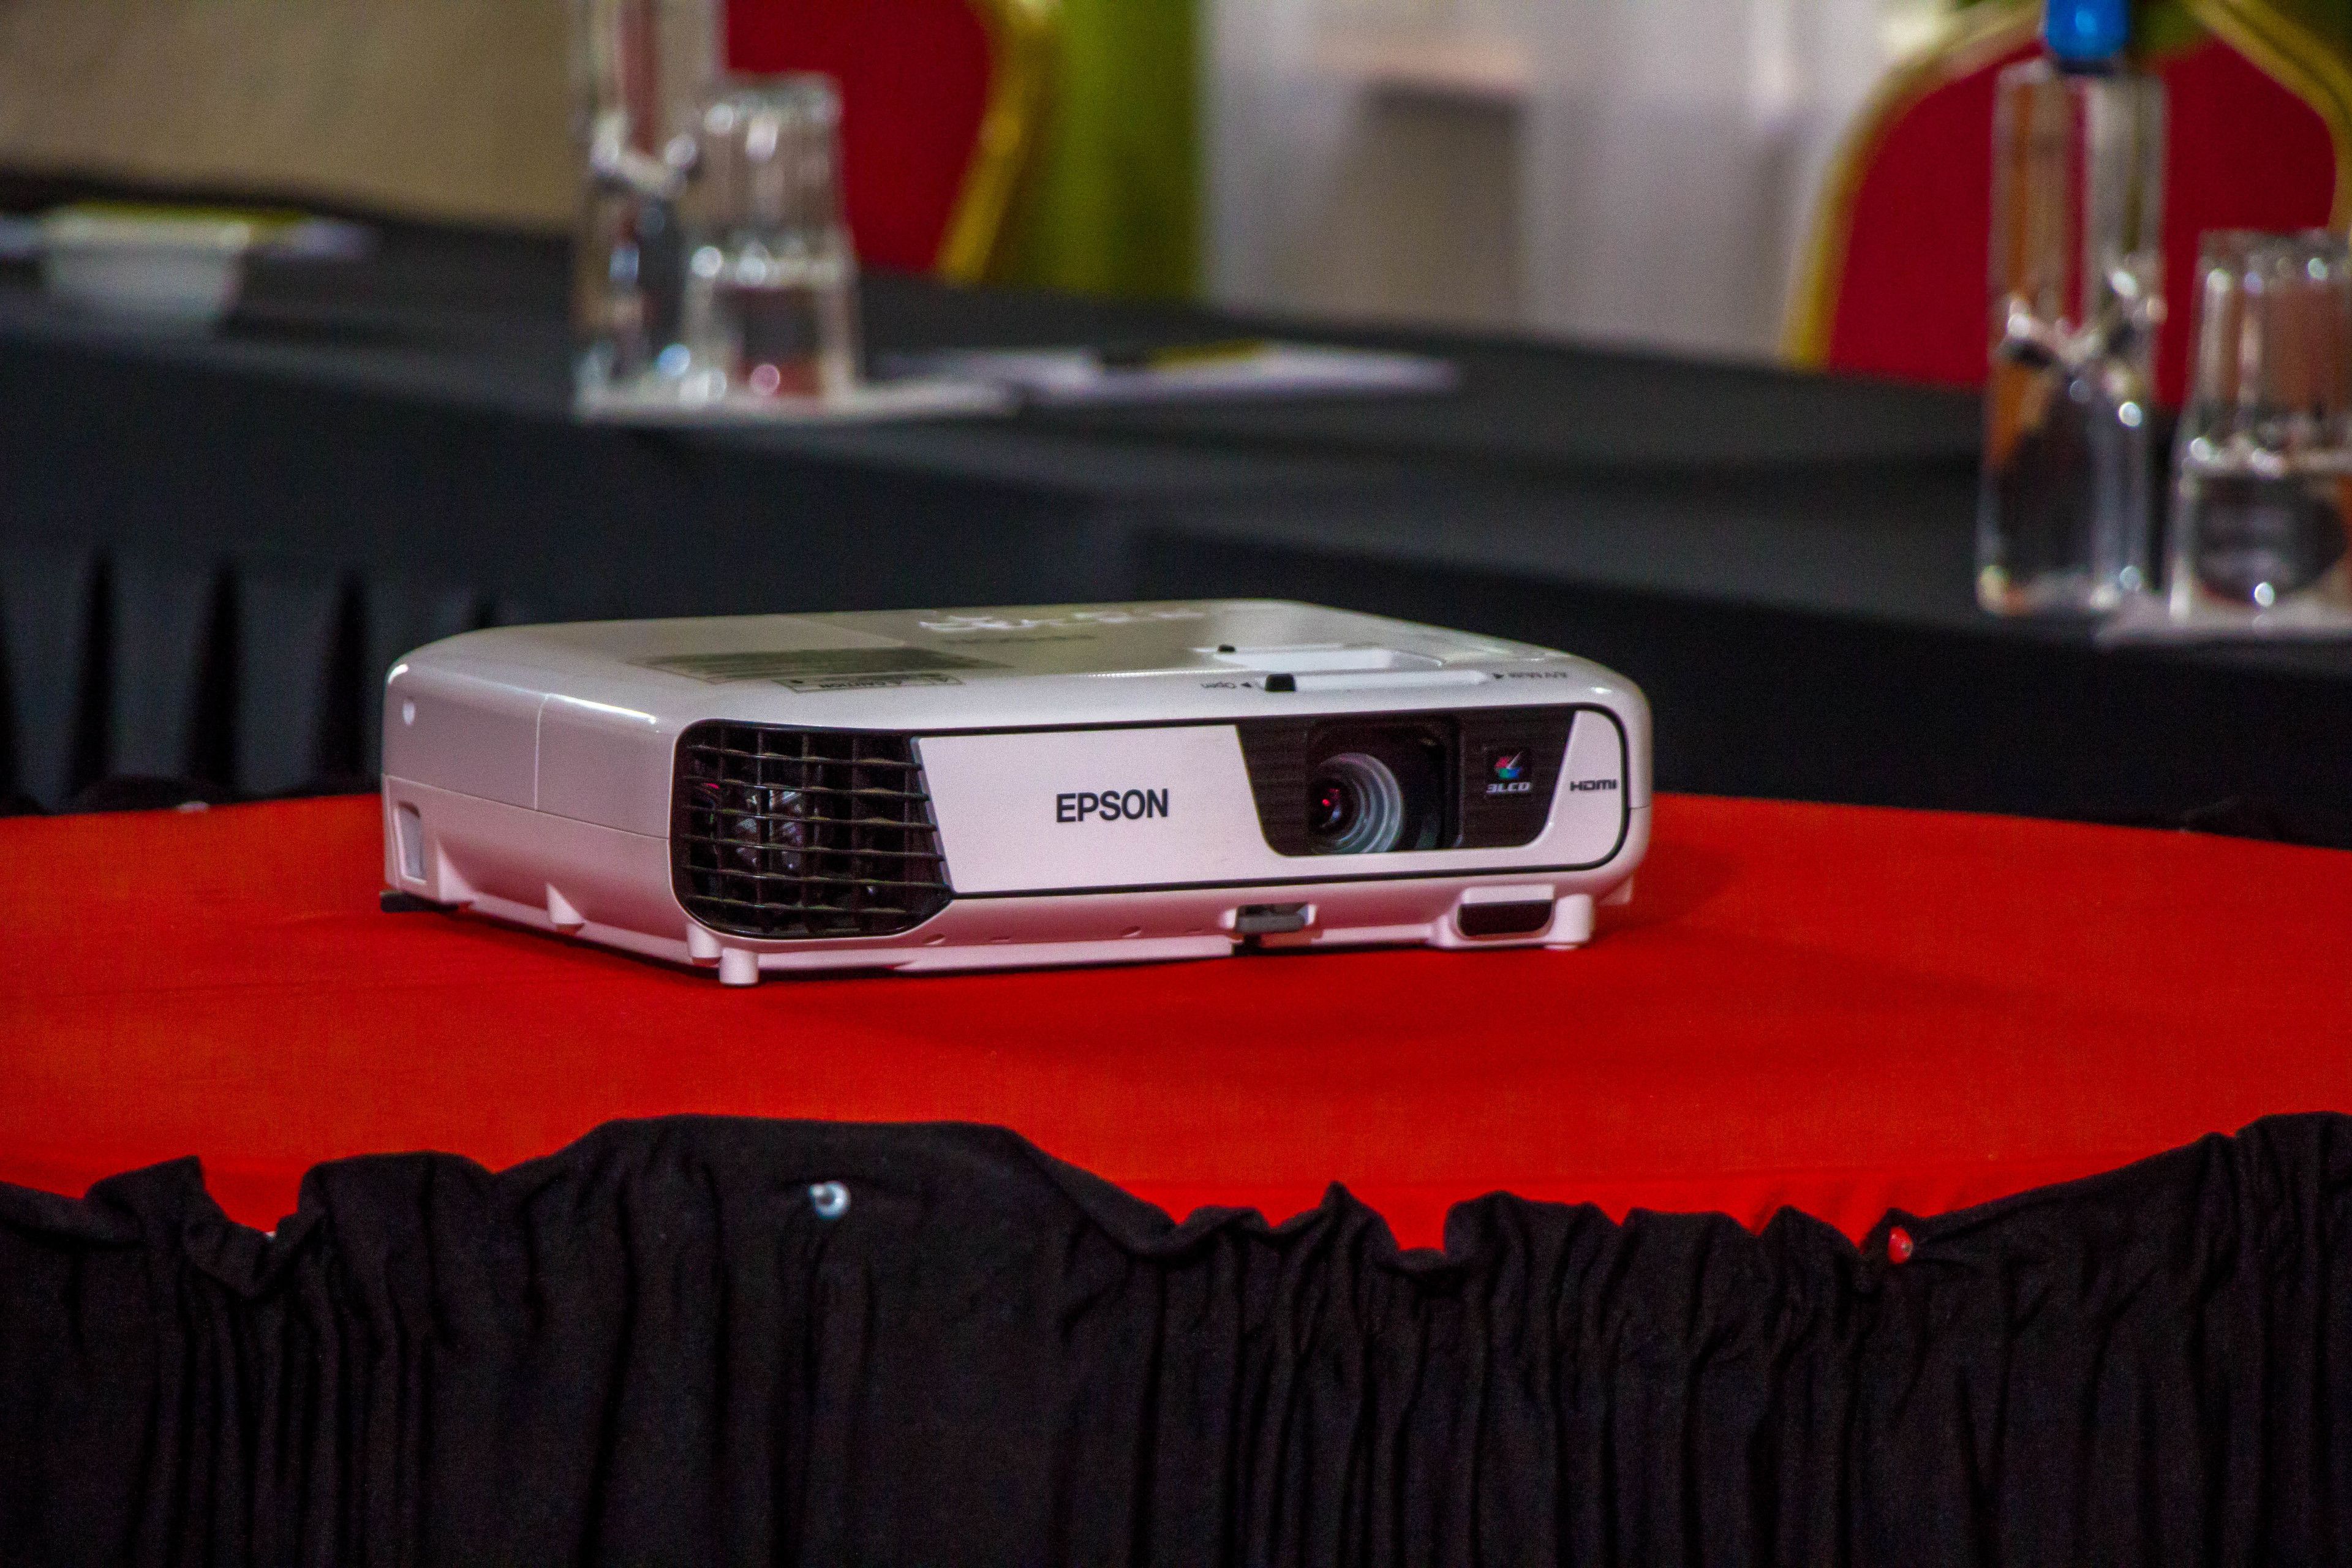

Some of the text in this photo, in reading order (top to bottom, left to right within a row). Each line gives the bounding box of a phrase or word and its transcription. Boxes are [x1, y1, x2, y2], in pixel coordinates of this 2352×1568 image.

[1487, 782, 1531, 793] 3LCD
[1569, 779, 1617, 791] HDMI
[1056, 788, 1168, 823] EPSON
